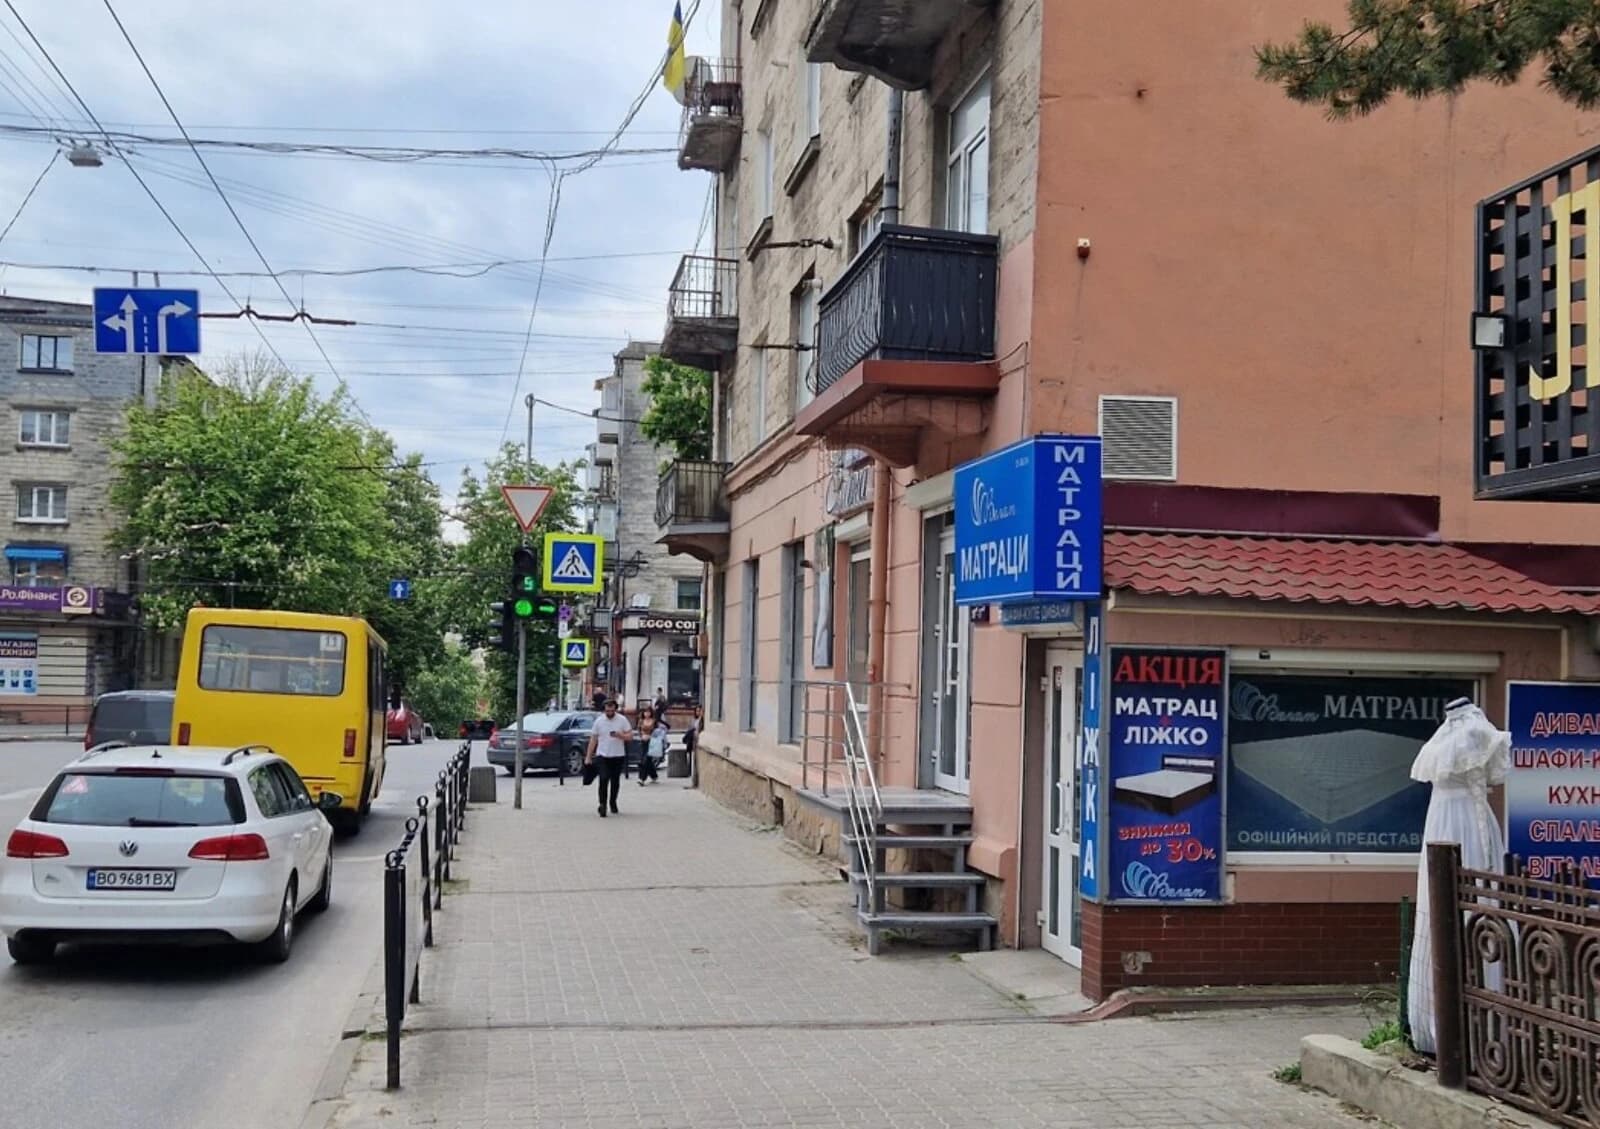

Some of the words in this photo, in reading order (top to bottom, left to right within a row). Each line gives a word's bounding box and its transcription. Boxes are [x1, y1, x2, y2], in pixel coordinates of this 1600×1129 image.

[1054, 445, 1085, 590] МАТРАЦИ
[961, 533, 1029, 583] МАТРАЦИ
[1114, 655, 1221, 689] АКЦІЯ
[1115, 697, 1218, 720] МАТРАЦ
[1123, 726, 1208, 746] ЛІЖКО
[1083, 616, 1100, 880] ЛІЖКА
[1514, 748, 1600, 769] ШАФИ-К
[1549, 785, 1600, 805] КУХН
[1238, 828, 1332, 845] ОФІЦІЙНИЙ
[1336, 831, 1423, 847] ПРЕДСТАВ
[1167, 838, 1216, 863] 30%
[120, 873, 150, 885] 9681
